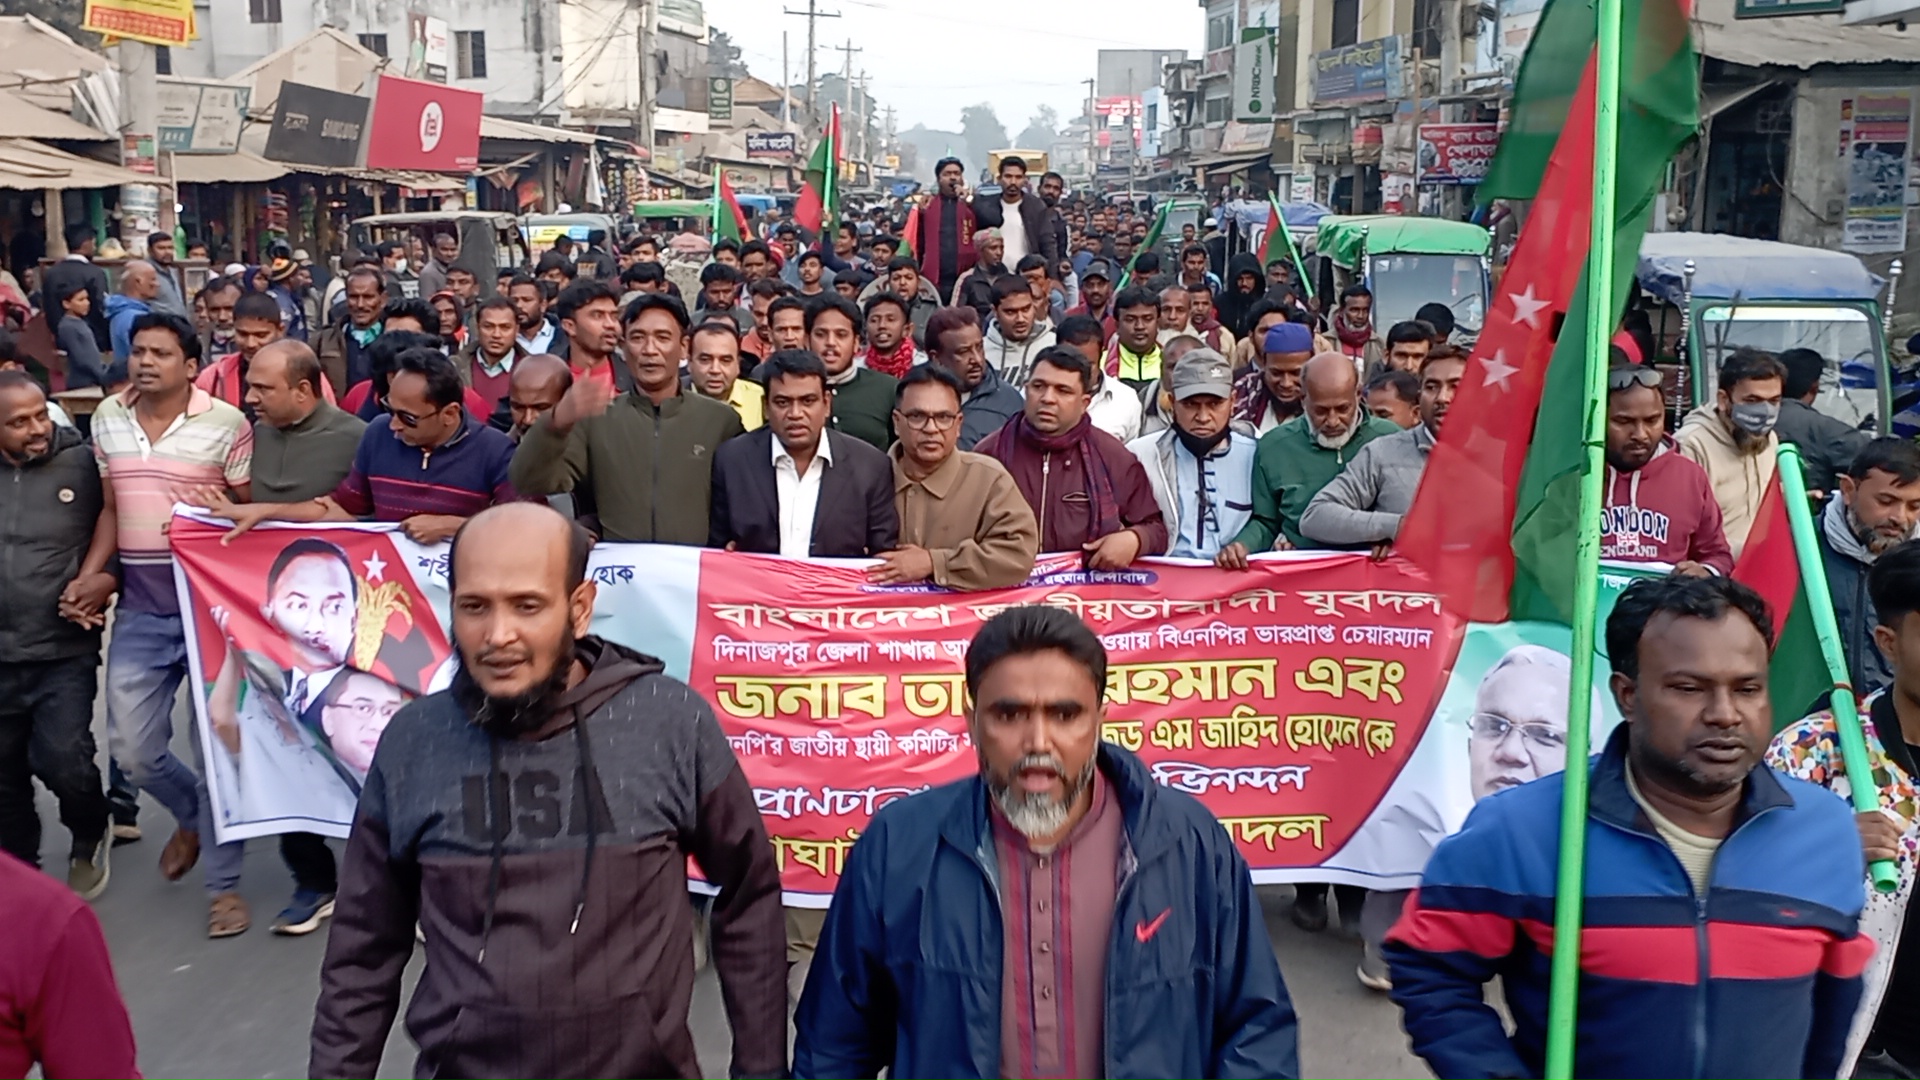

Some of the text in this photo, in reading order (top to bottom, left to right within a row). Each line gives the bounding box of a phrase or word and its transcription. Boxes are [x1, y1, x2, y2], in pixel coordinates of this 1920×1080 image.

[1250, 67, 1262, 98] NRBC
[1600, 505, 1669, 544] ONDON
[707, 602, 957, 631] বাংলাদেশ
[1295, 589, 1442, 618] যুবদল
[712, 634, 811, 667] দিনাজপুর
[816, 640, 871, 664] জেলা
[877, 638, 936, 661] শাখার
[1097, 631, 1152, 652] ওয়ায়
[1156, 621, 1249, 648] বিএনপির
[1254, 623, 1336, 646] ভারপ্রাপ্ত
[1342, 624, 1434, 649] চেয়ারম্যান
[714, 673, 889, 720] জনাব
[1103, 658, 1278, 705] রহমান
[1294, 657, 1405, 705] এবং
[787, 729, 850, 757] জাতীয়
[851, 728, 893, 762] স্থায়ী
[894, 728, 960, 756] কমিটির
[1150, 719, 1193, 751] এম
[1198, 704, 1279, 749] জাহিদ
[1285, 713, 1361, 752] হোসেন
[1363, 719, 1397, 758] কে
[461, 765, 617, 843] USA
